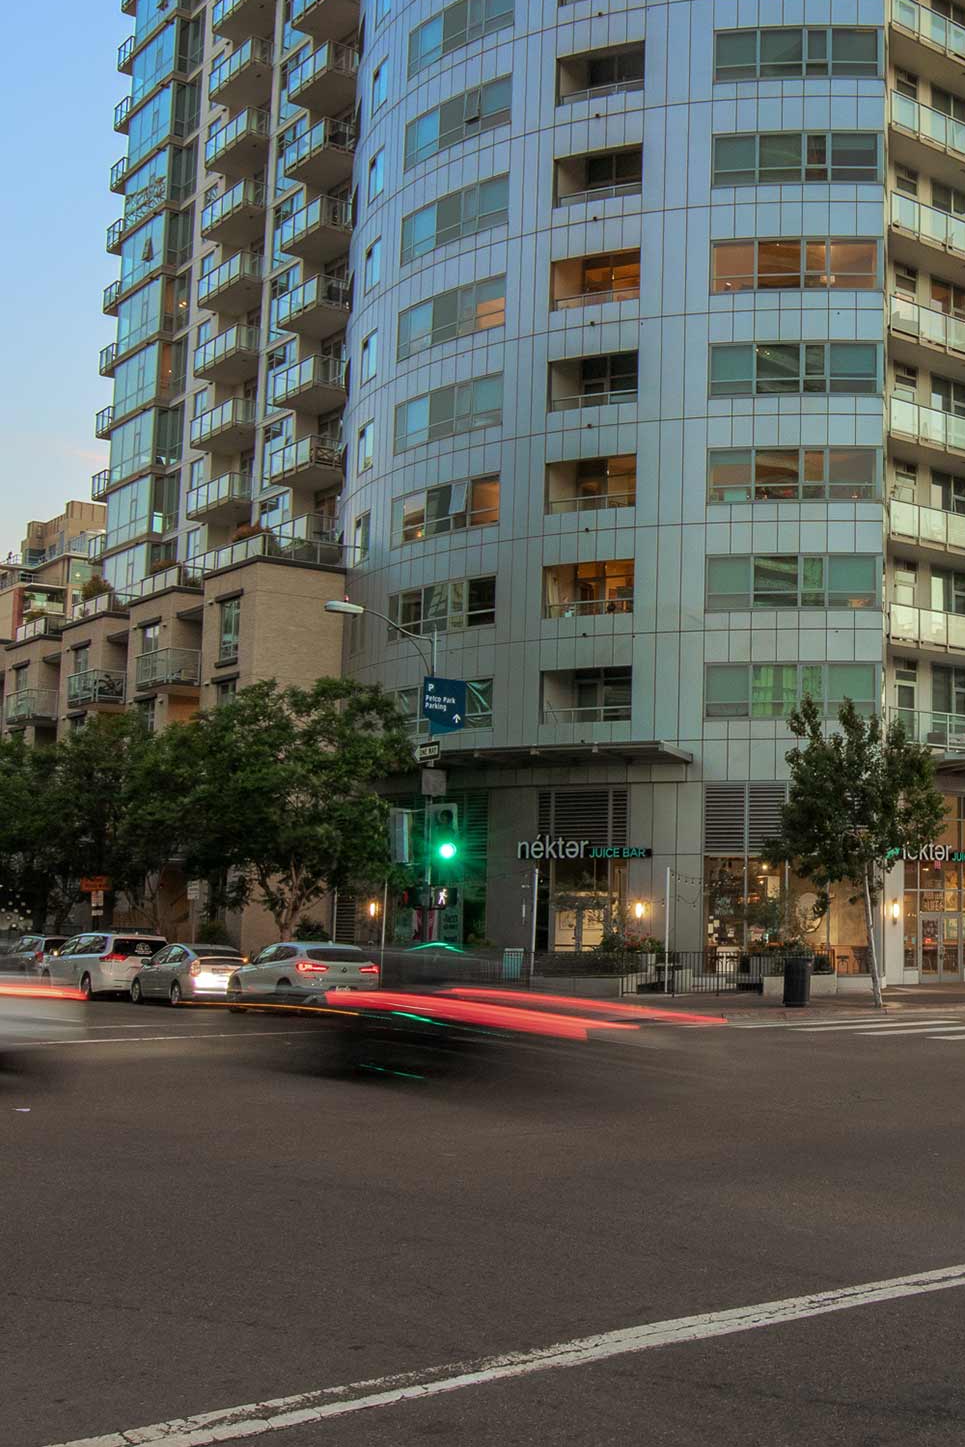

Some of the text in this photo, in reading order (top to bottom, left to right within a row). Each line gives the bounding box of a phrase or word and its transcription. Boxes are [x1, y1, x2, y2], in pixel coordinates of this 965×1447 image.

[428, 683, 434, 692] P
[425, 695, 456, 704] Petco Park
[425, 702, 447, 711] Parking
[589, 847, 619, 858] JUICE
[622, 847, 646, 858] BAR
